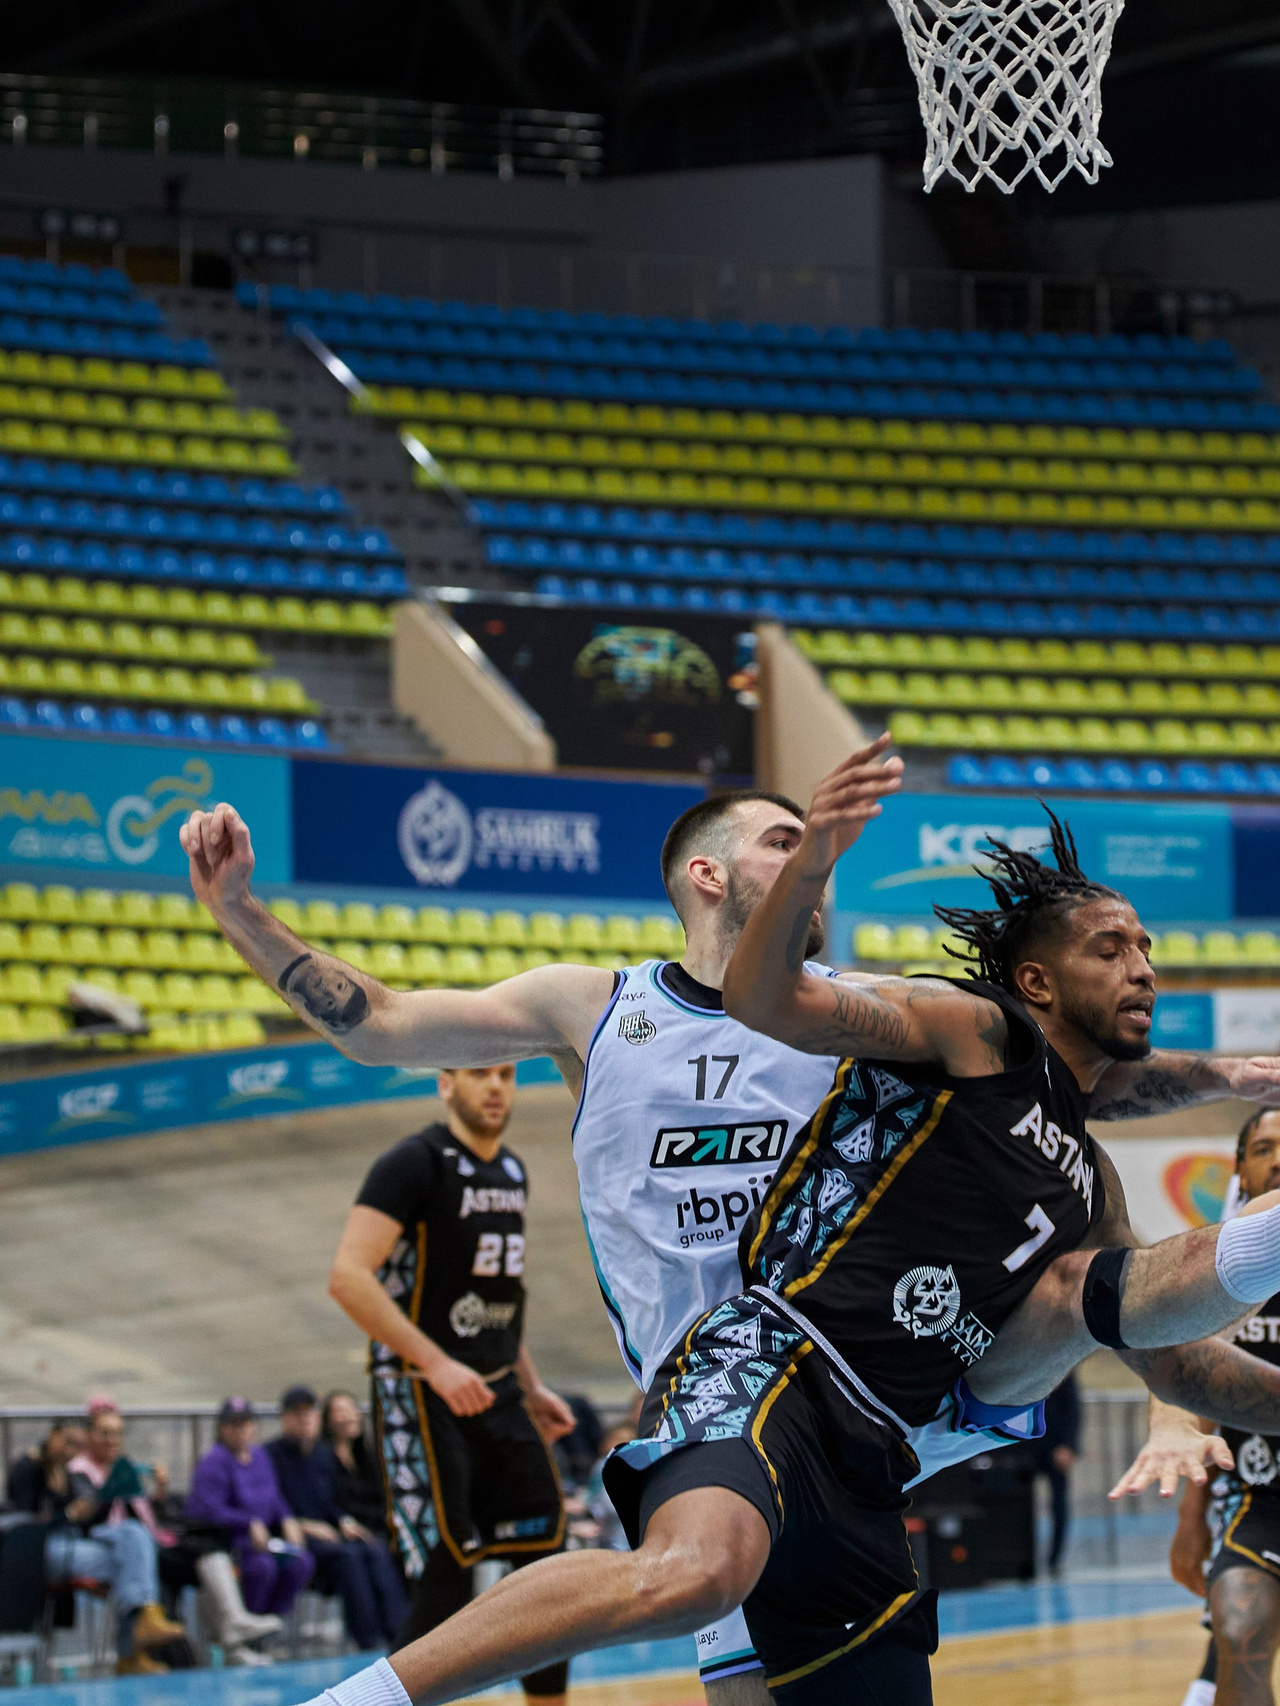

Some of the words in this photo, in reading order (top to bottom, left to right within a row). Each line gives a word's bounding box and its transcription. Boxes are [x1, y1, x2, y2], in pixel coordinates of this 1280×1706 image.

[688, 1054, 740, 1101] 17
[655, 1124, 782, 1165] PARI
[471, 1233, 525, 1278] 22
[680, 1228, 724, 1249] group
[1002, 1203, 1055, 1274] 7
